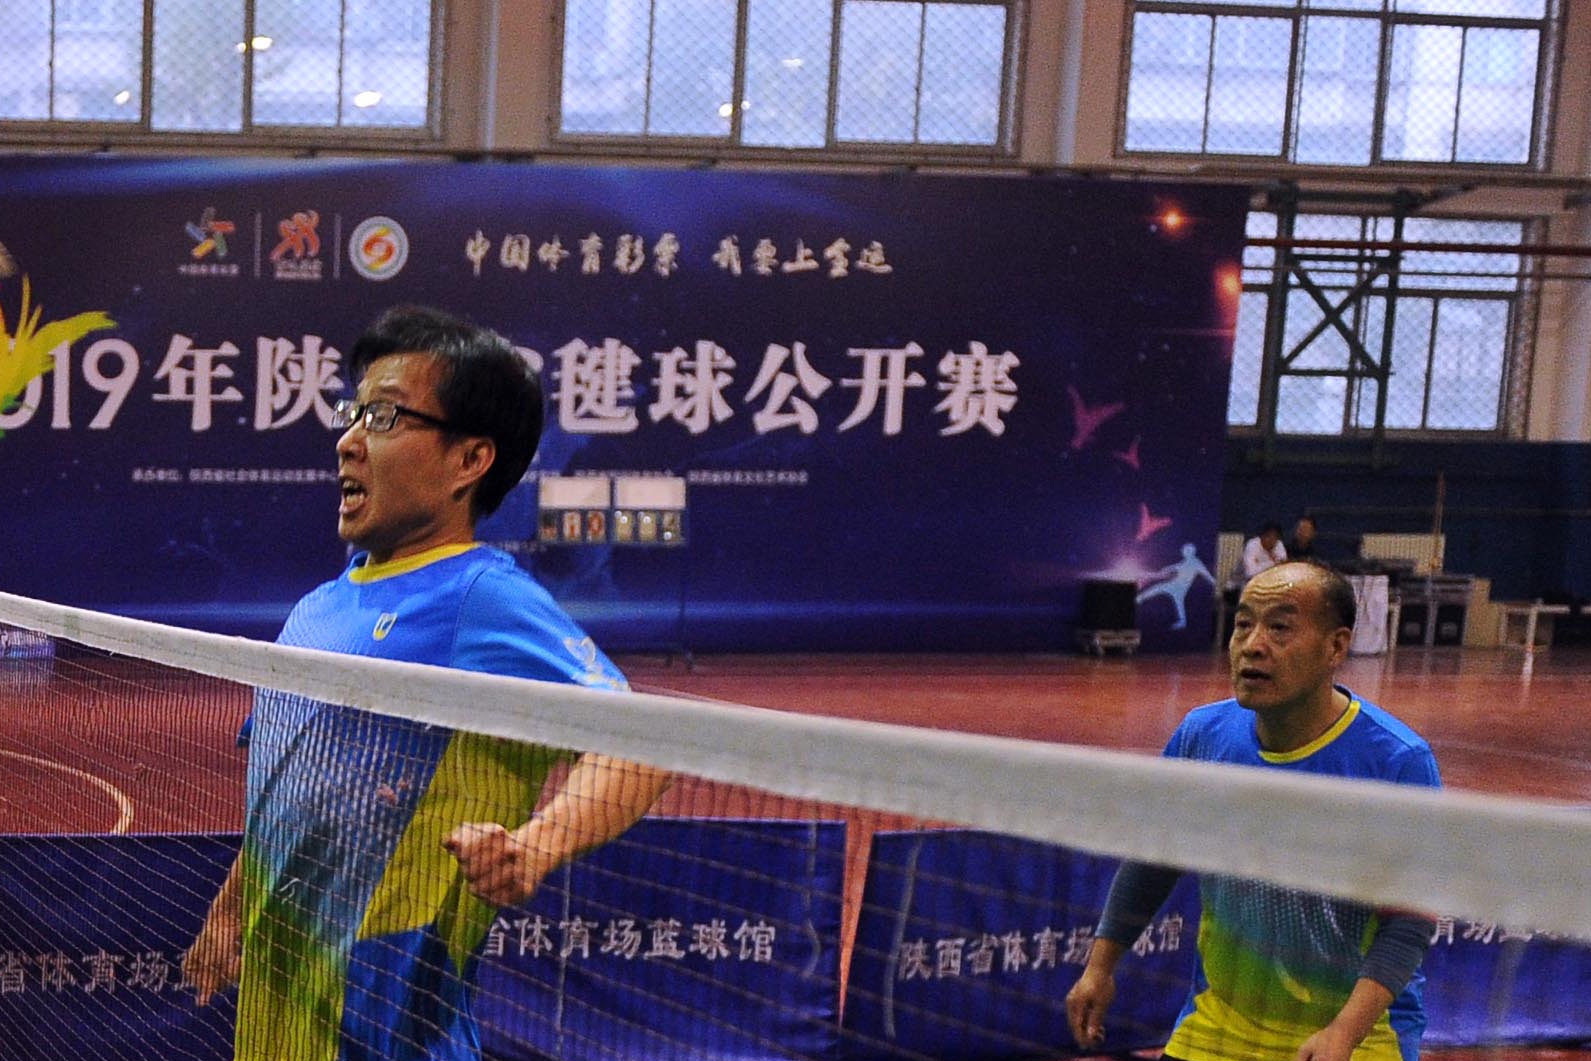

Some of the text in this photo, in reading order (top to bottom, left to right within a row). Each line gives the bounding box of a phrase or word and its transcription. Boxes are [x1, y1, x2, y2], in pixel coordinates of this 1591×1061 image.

[898, 914, 1184, 981] 陕西省体育场馆
